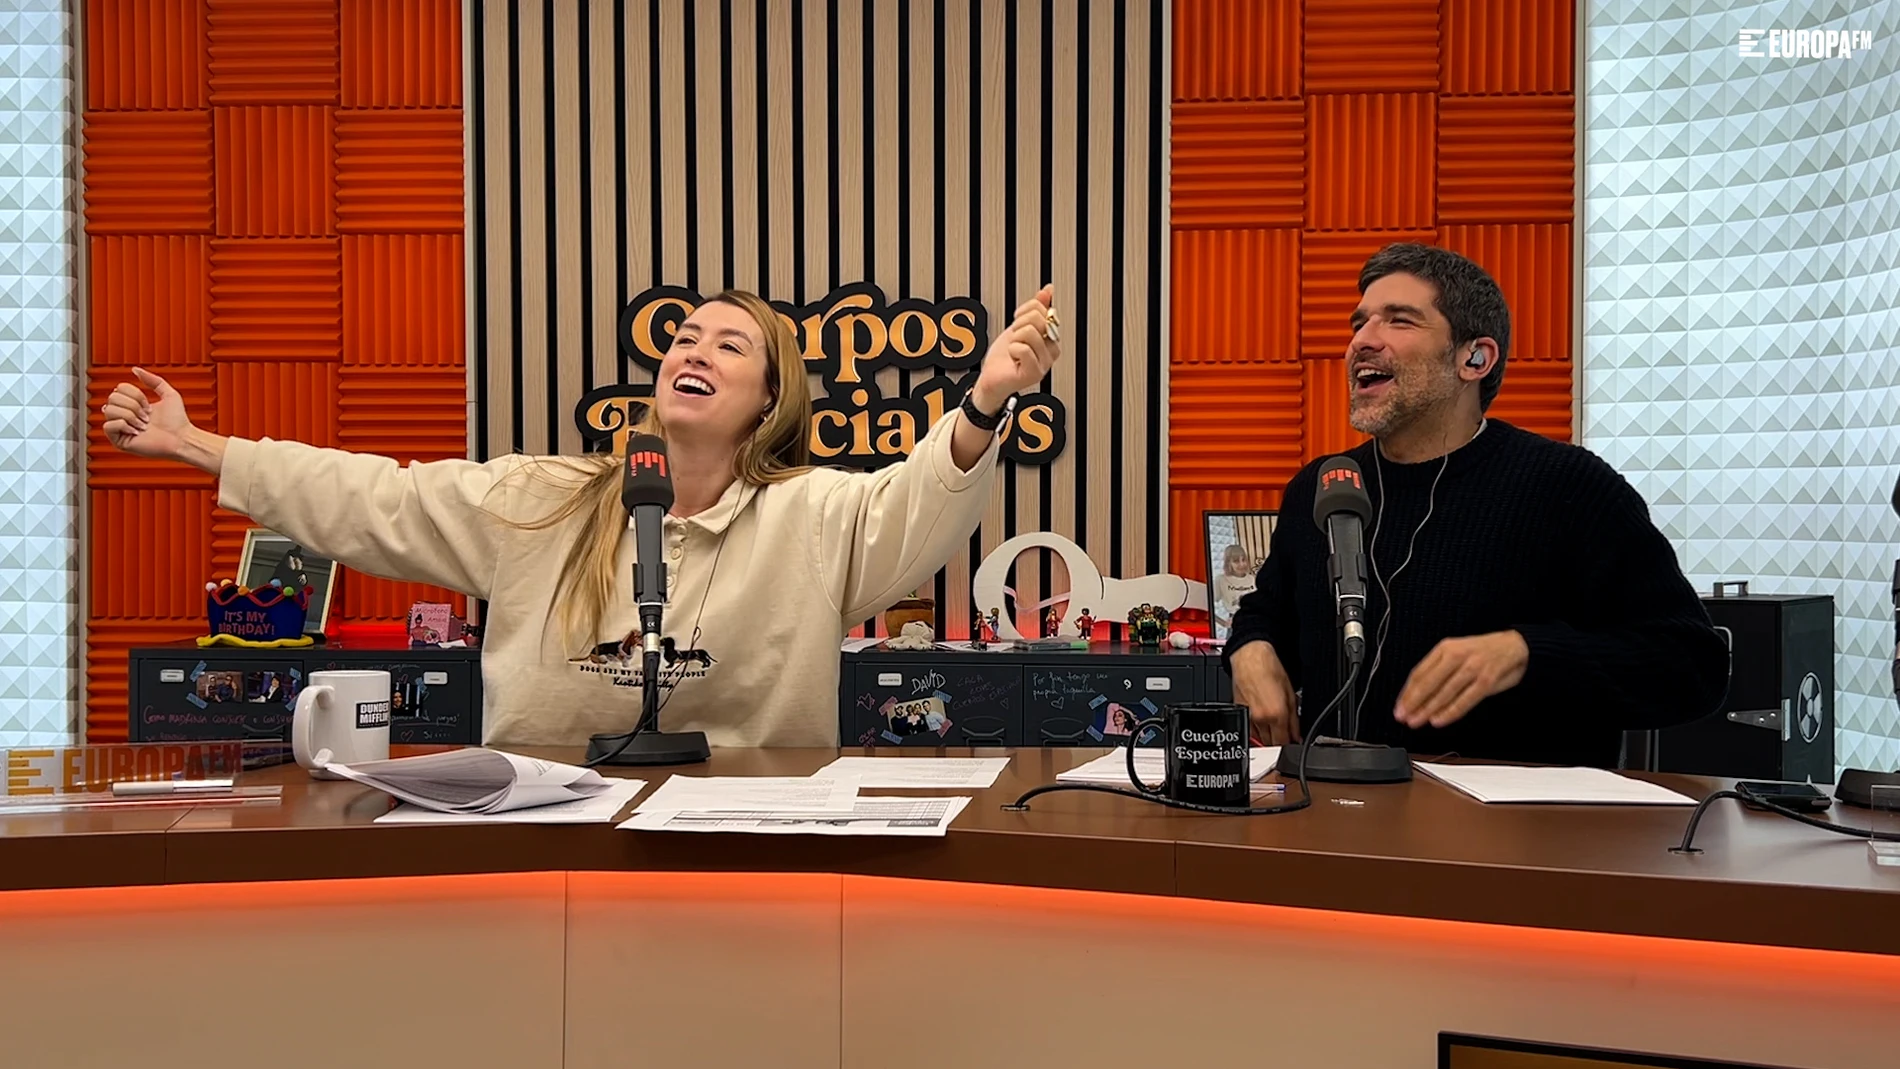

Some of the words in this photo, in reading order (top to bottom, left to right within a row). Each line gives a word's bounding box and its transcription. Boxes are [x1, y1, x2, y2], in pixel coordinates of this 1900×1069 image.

[224, 610, 243, 622] IT'S
[246, 611, 267, 623] MY
[218, 622, 275, 635] BIRTHDAY!
[911, 669, 947, 695] DAVID
[1181, 729, 1240, 747] Cuerpos
